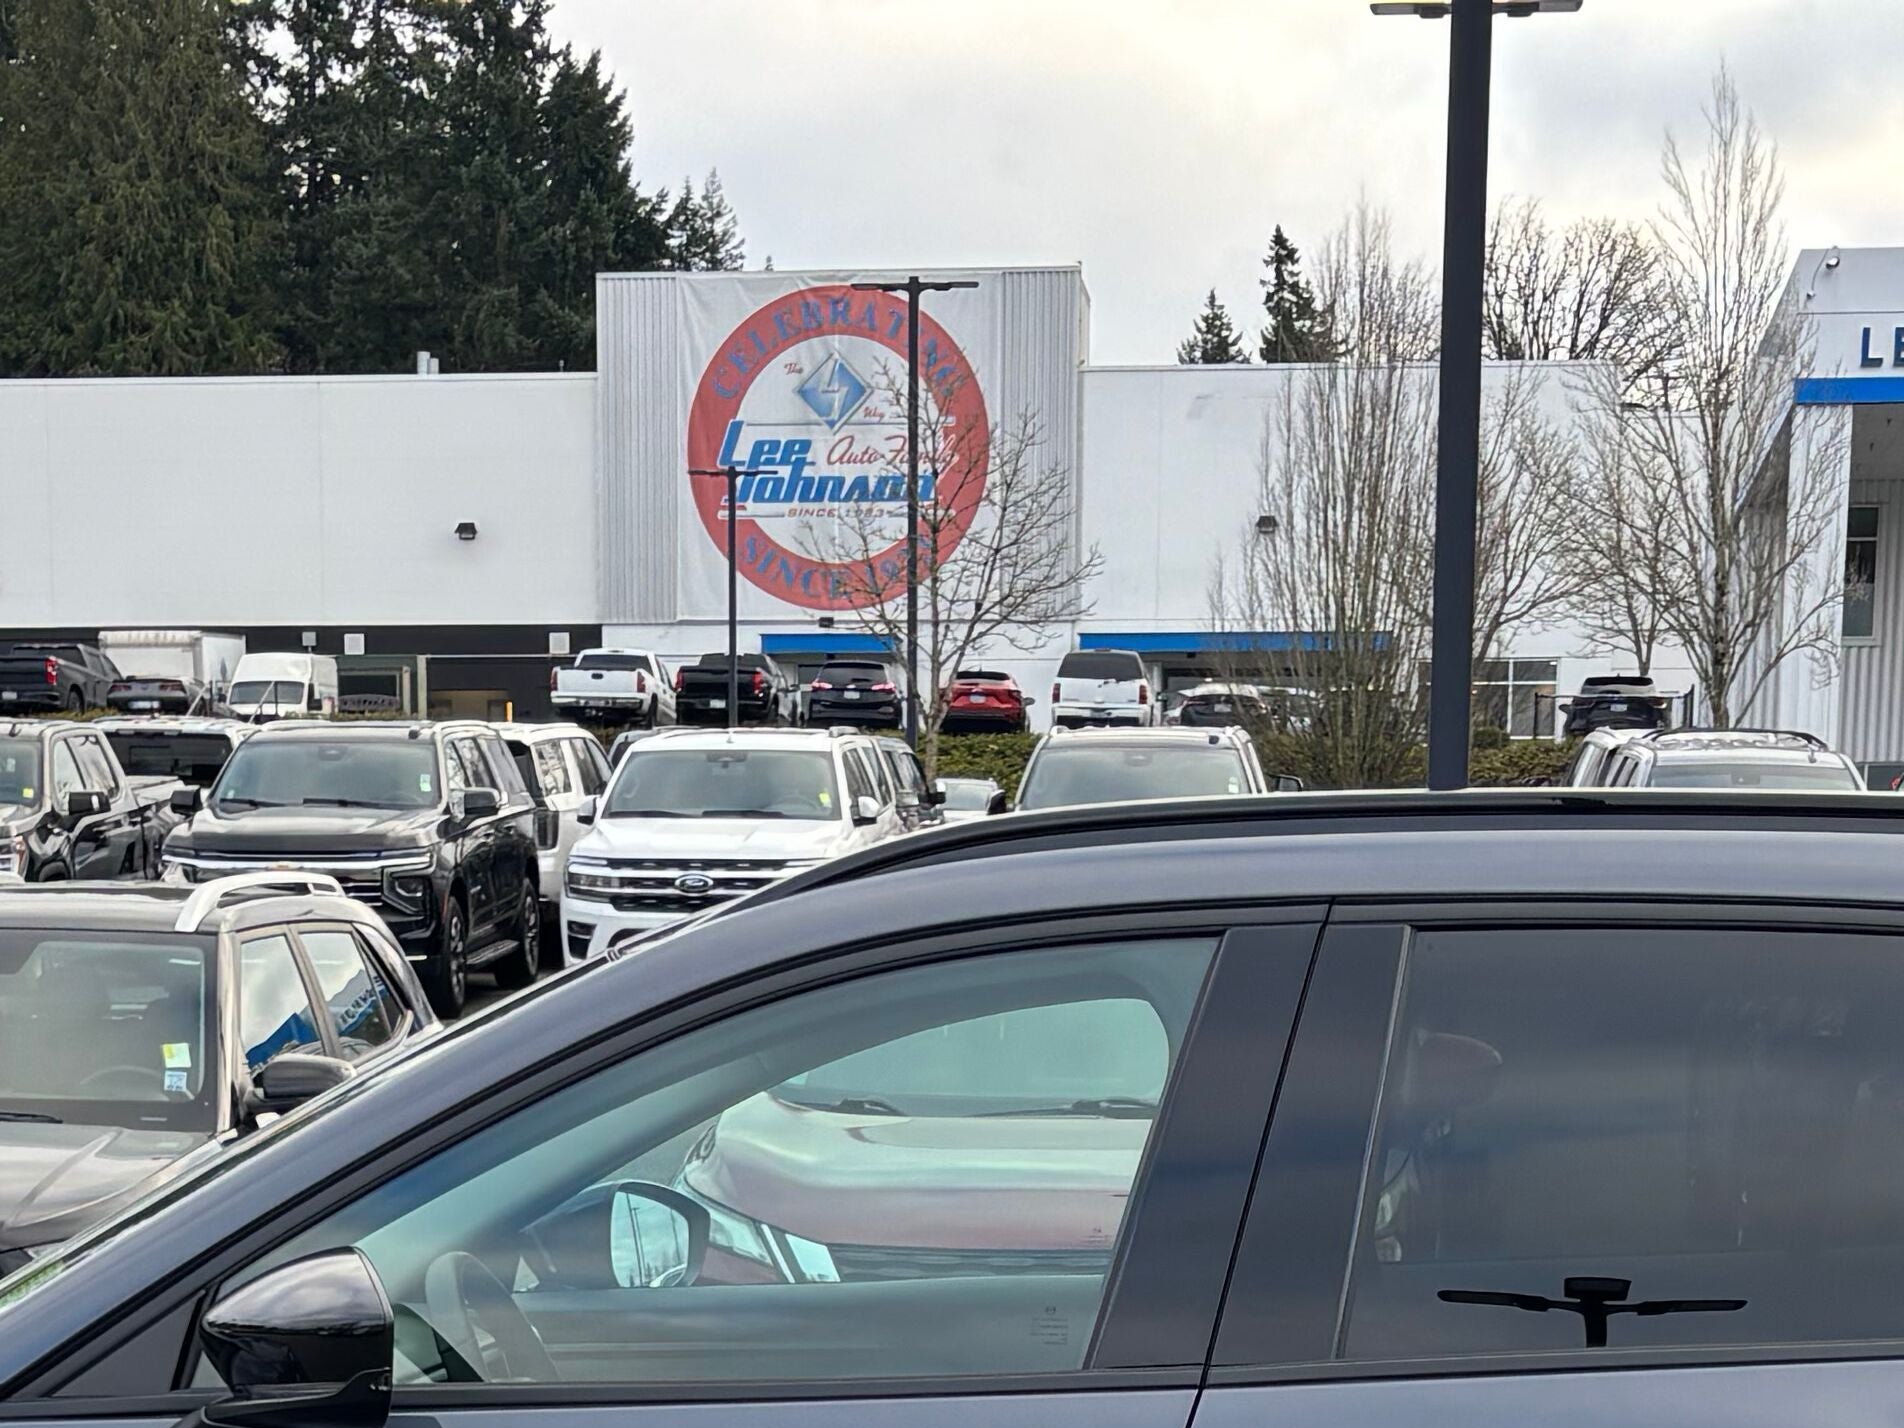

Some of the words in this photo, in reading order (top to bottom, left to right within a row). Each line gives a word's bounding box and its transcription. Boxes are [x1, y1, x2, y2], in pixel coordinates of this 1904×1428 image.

[712, 297, 966, 399] CELEBRATNG
[719, 420, 816, 469] Lee
[827, 435, 880, 466] Auto
[724, 464, 937, 503] Johnson
[787, 508, 837, 518] SINCE
[744, 535, 853, 600] SINCE
